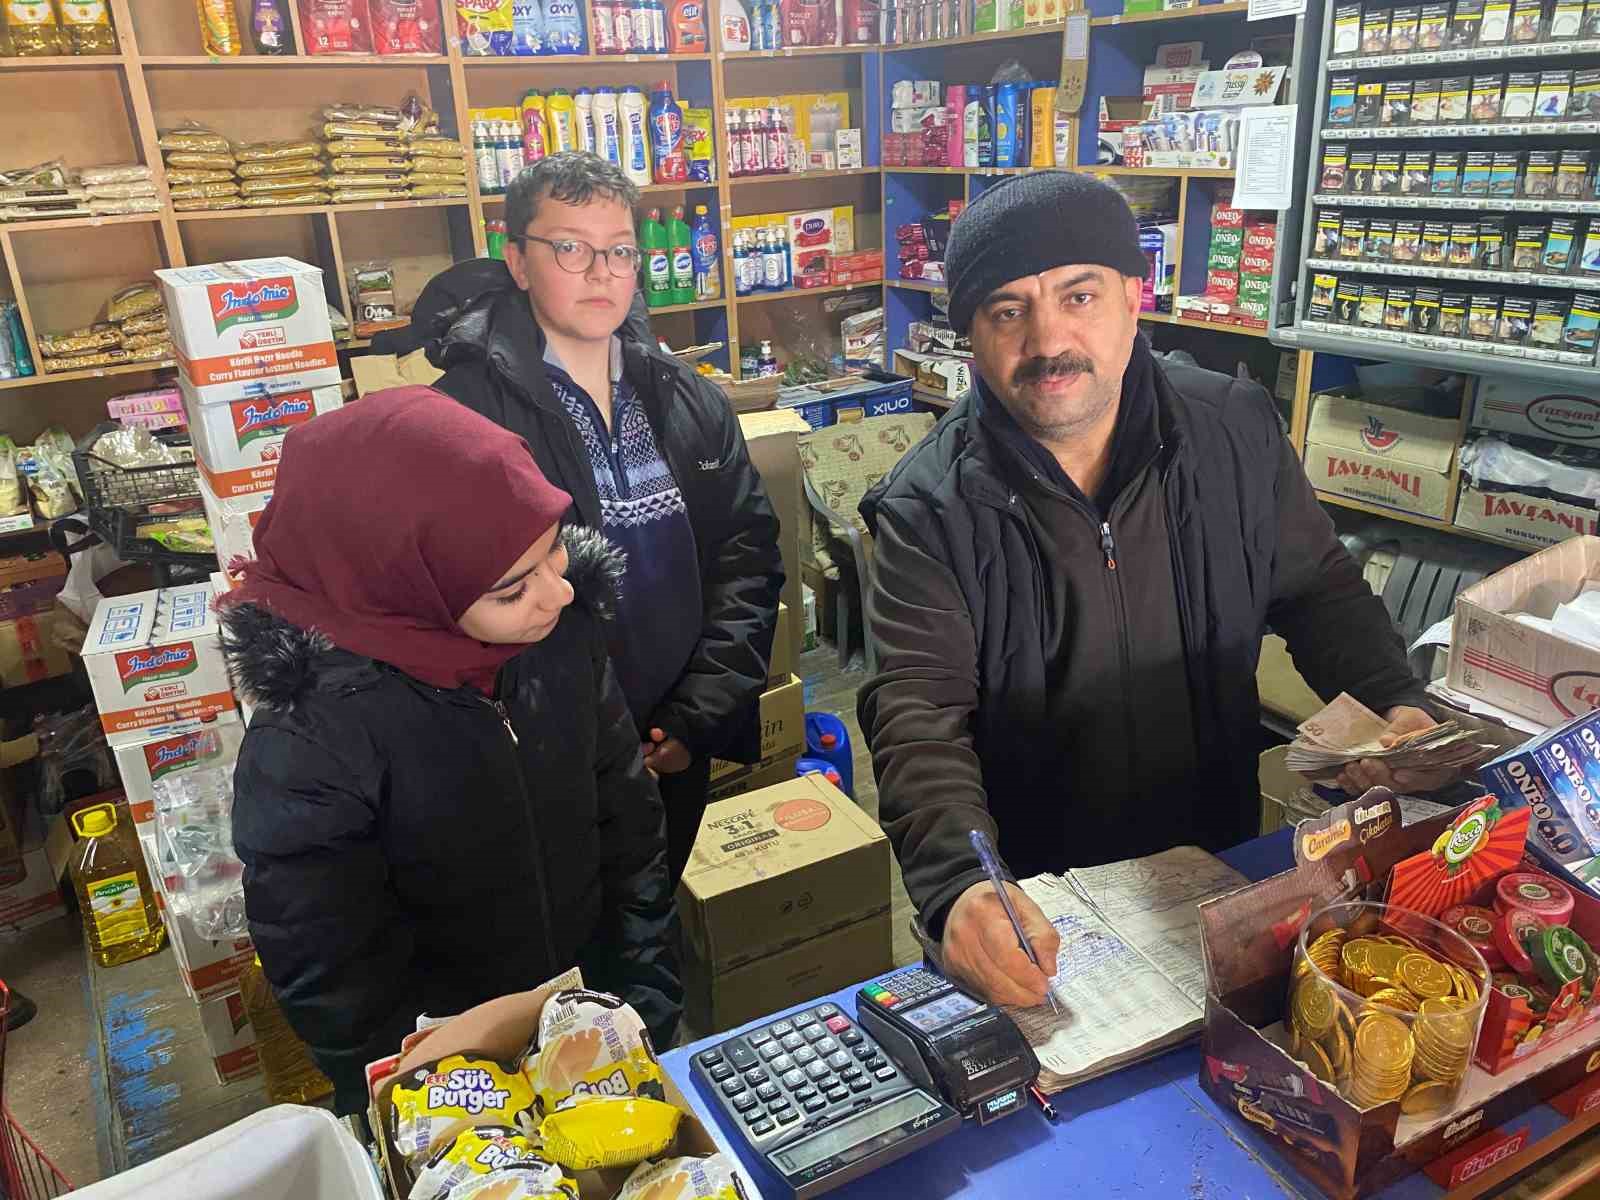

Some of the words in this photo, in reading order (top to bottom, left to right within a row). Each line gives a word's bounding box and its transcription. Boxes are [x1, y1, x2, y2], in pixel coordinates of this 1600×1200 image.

[550, 4, 574, 16] OXY
[1327, 456, 1421, 498] TAVŞANLI
[1506, 760, 1553, 820] ONEO
[1550, 743, 1592, 802] ONEO
[447, 1068, 494, 1090] Süt
[427, 1084, 511, 1116] Burger
